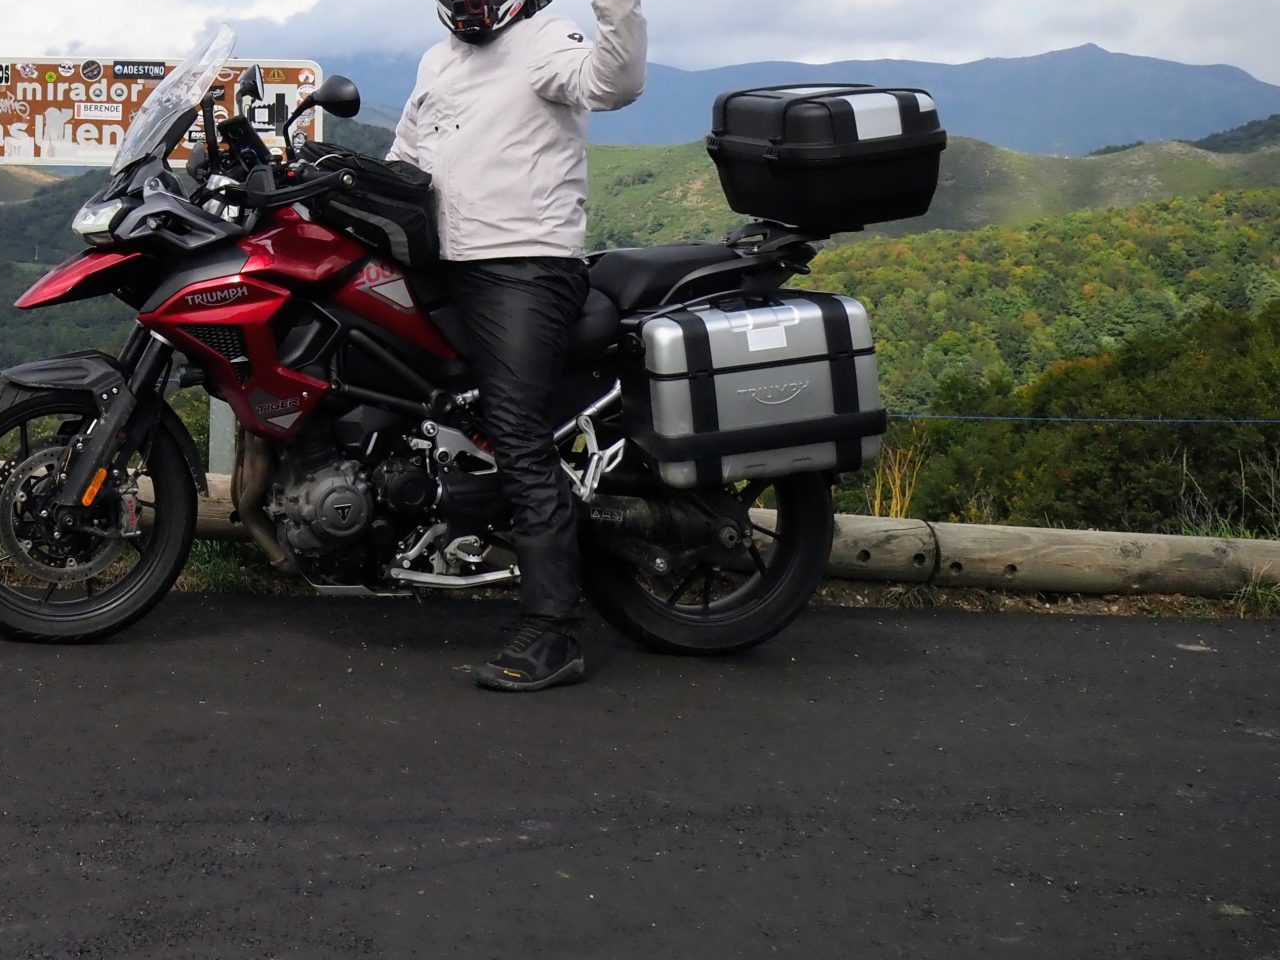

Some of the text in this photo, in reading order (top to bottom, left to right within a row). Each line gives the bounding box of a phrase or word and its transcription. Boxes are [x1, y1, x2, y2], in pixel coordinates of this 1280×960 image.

[17, 79, 144, 102] mirador
[83, 104, 120, 113] BERENDE
[185, 286, 249, 306] TRIUMPH
[256, 396, 301, 414] TIGER
